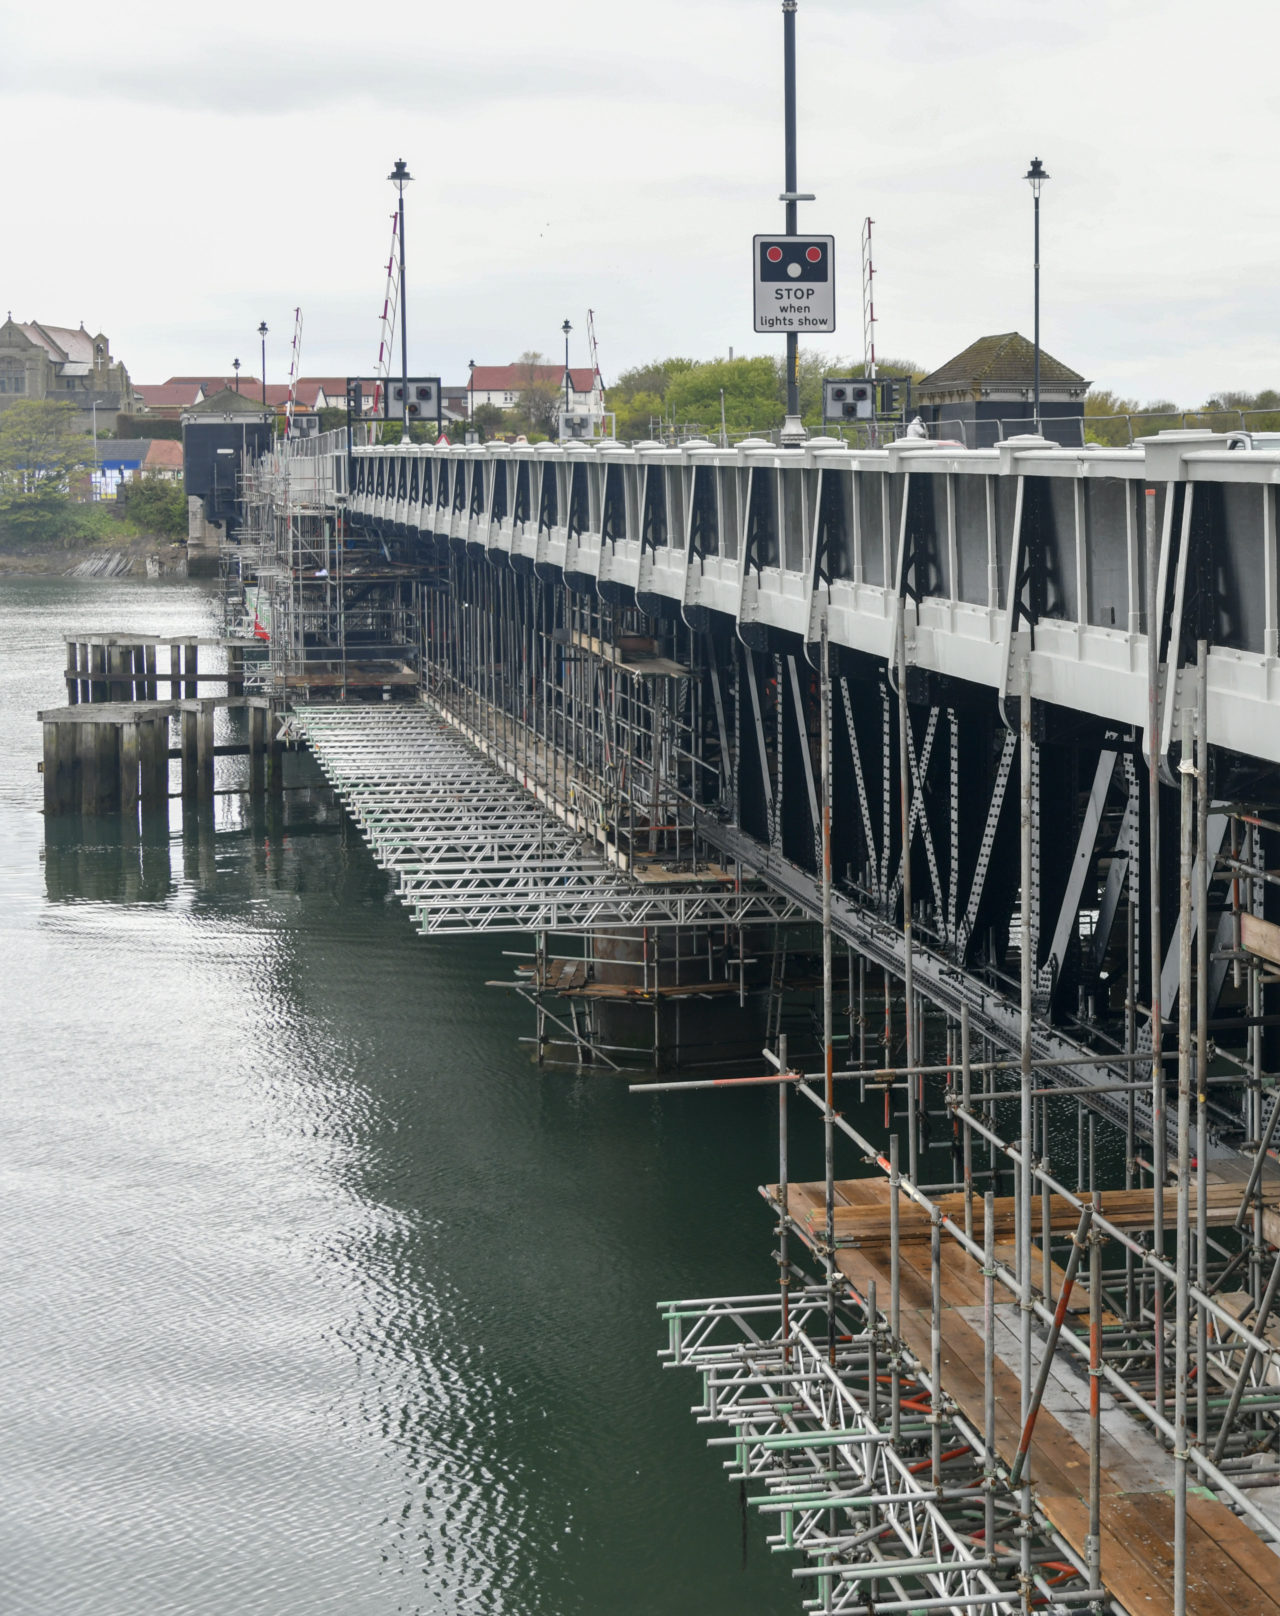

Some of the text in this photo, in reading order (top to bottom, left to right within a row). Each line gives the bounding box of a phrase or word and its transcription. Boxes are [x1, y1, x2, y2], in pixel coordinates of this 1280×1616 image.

[774, 288, 815, 300] STOP
[779, 304, 811, 313] when
[760, 316, 828, 328] lights show
